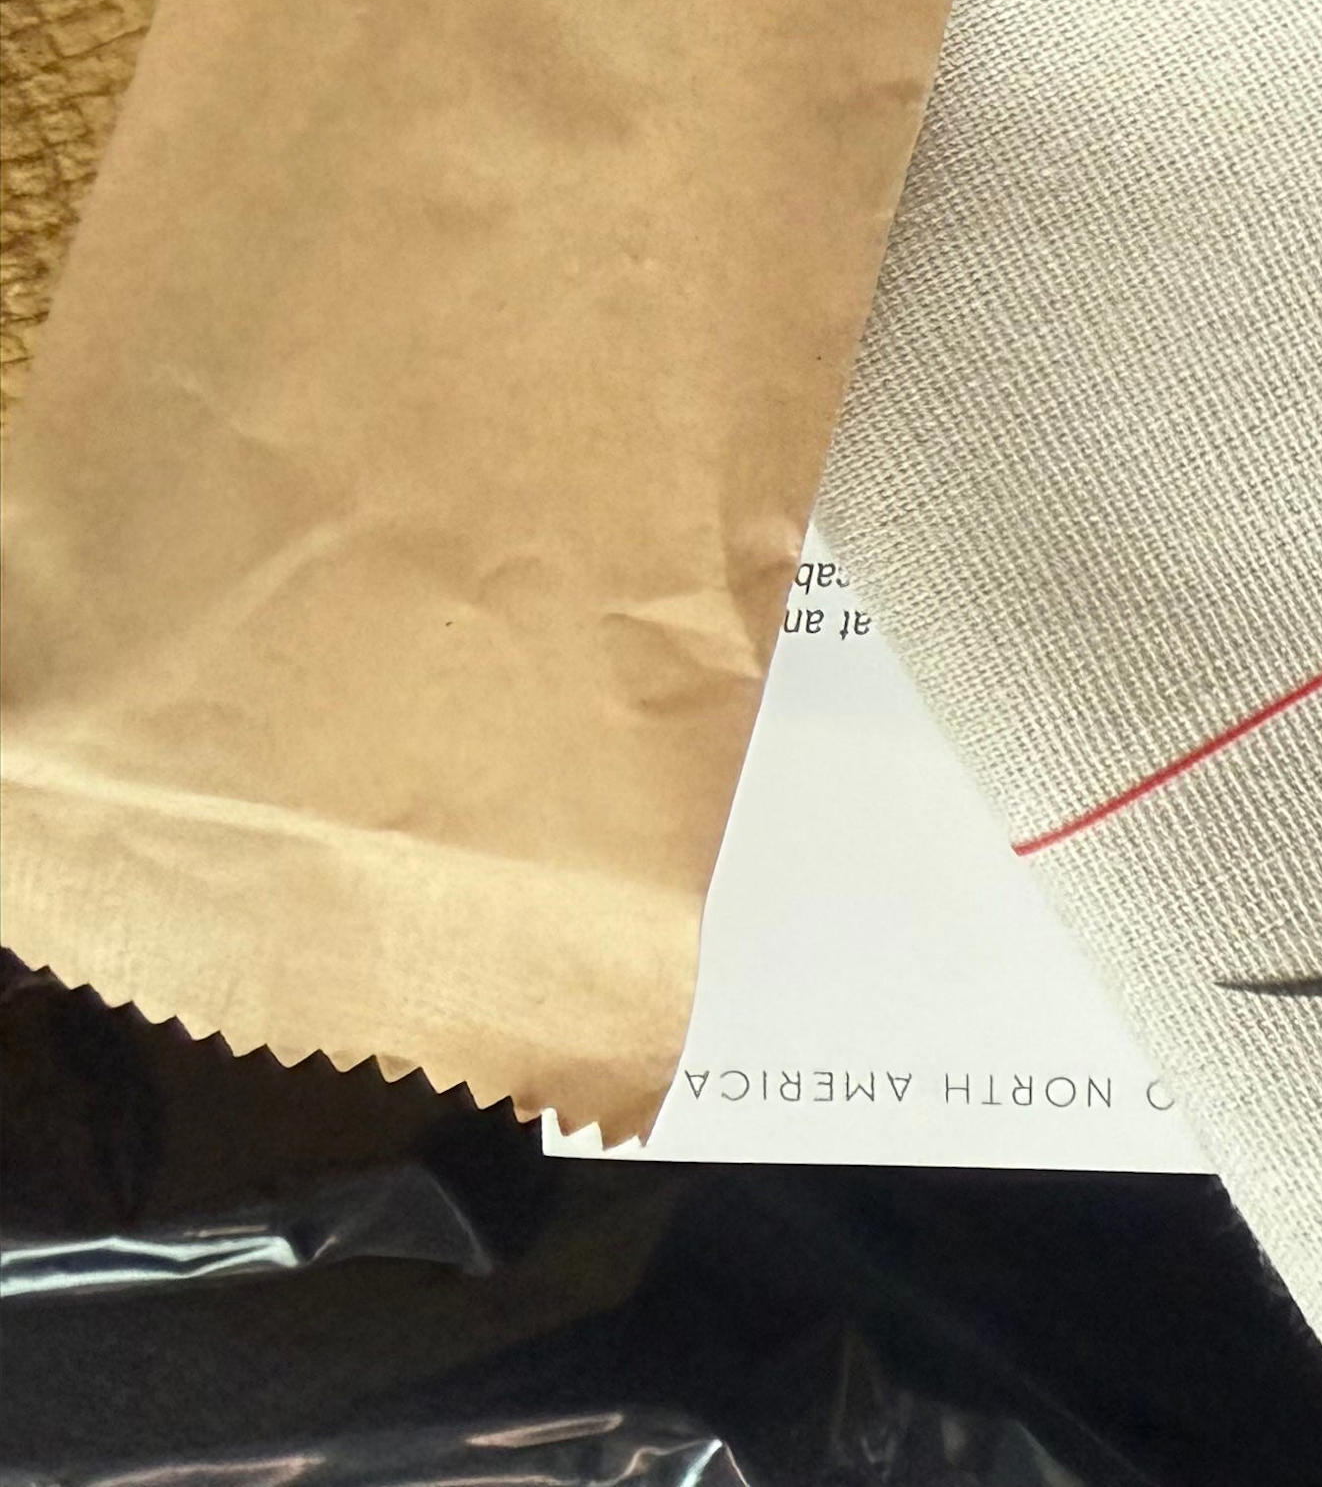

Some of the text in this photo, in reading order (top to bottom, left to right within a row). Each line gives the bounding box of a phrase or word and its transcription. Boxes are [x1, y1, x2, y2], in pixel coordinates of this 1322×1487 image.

[840, 610, 872, 641] at
[684, 1069, 912, 1104] AMERICA
[945, 1072, 1112, 1108] NORTH
